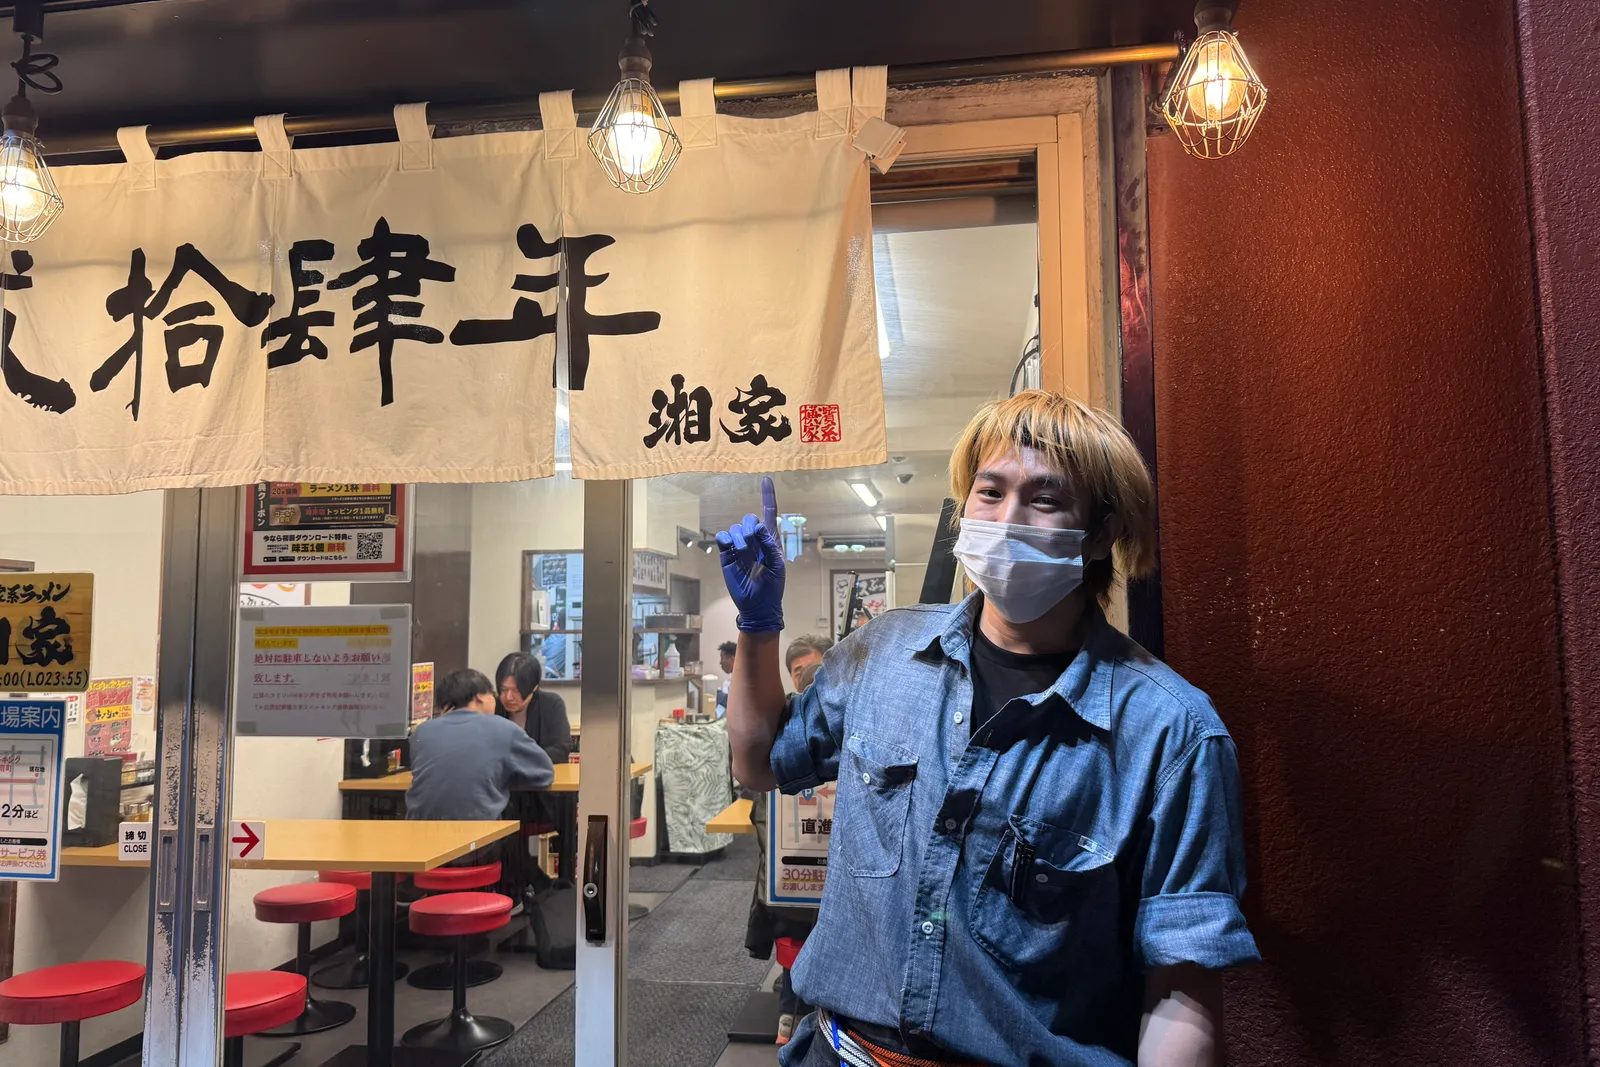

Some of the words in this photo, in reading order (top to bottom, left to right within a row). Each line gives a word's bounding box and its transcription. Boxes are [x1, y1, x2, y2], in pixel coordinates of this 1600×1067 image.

[644, 373, 793, 448] 湘家
[291, 543, 325, 553] 味玉1個
[0, 606, 74, 667] 家
[254, 652, 381, 664] 絶対に駐車しないようお願い
[253, 673, 296, 684] 致します。
[124, 844, 148, 853] CLOSE
[782, 868, 827, 881] 30分駐
